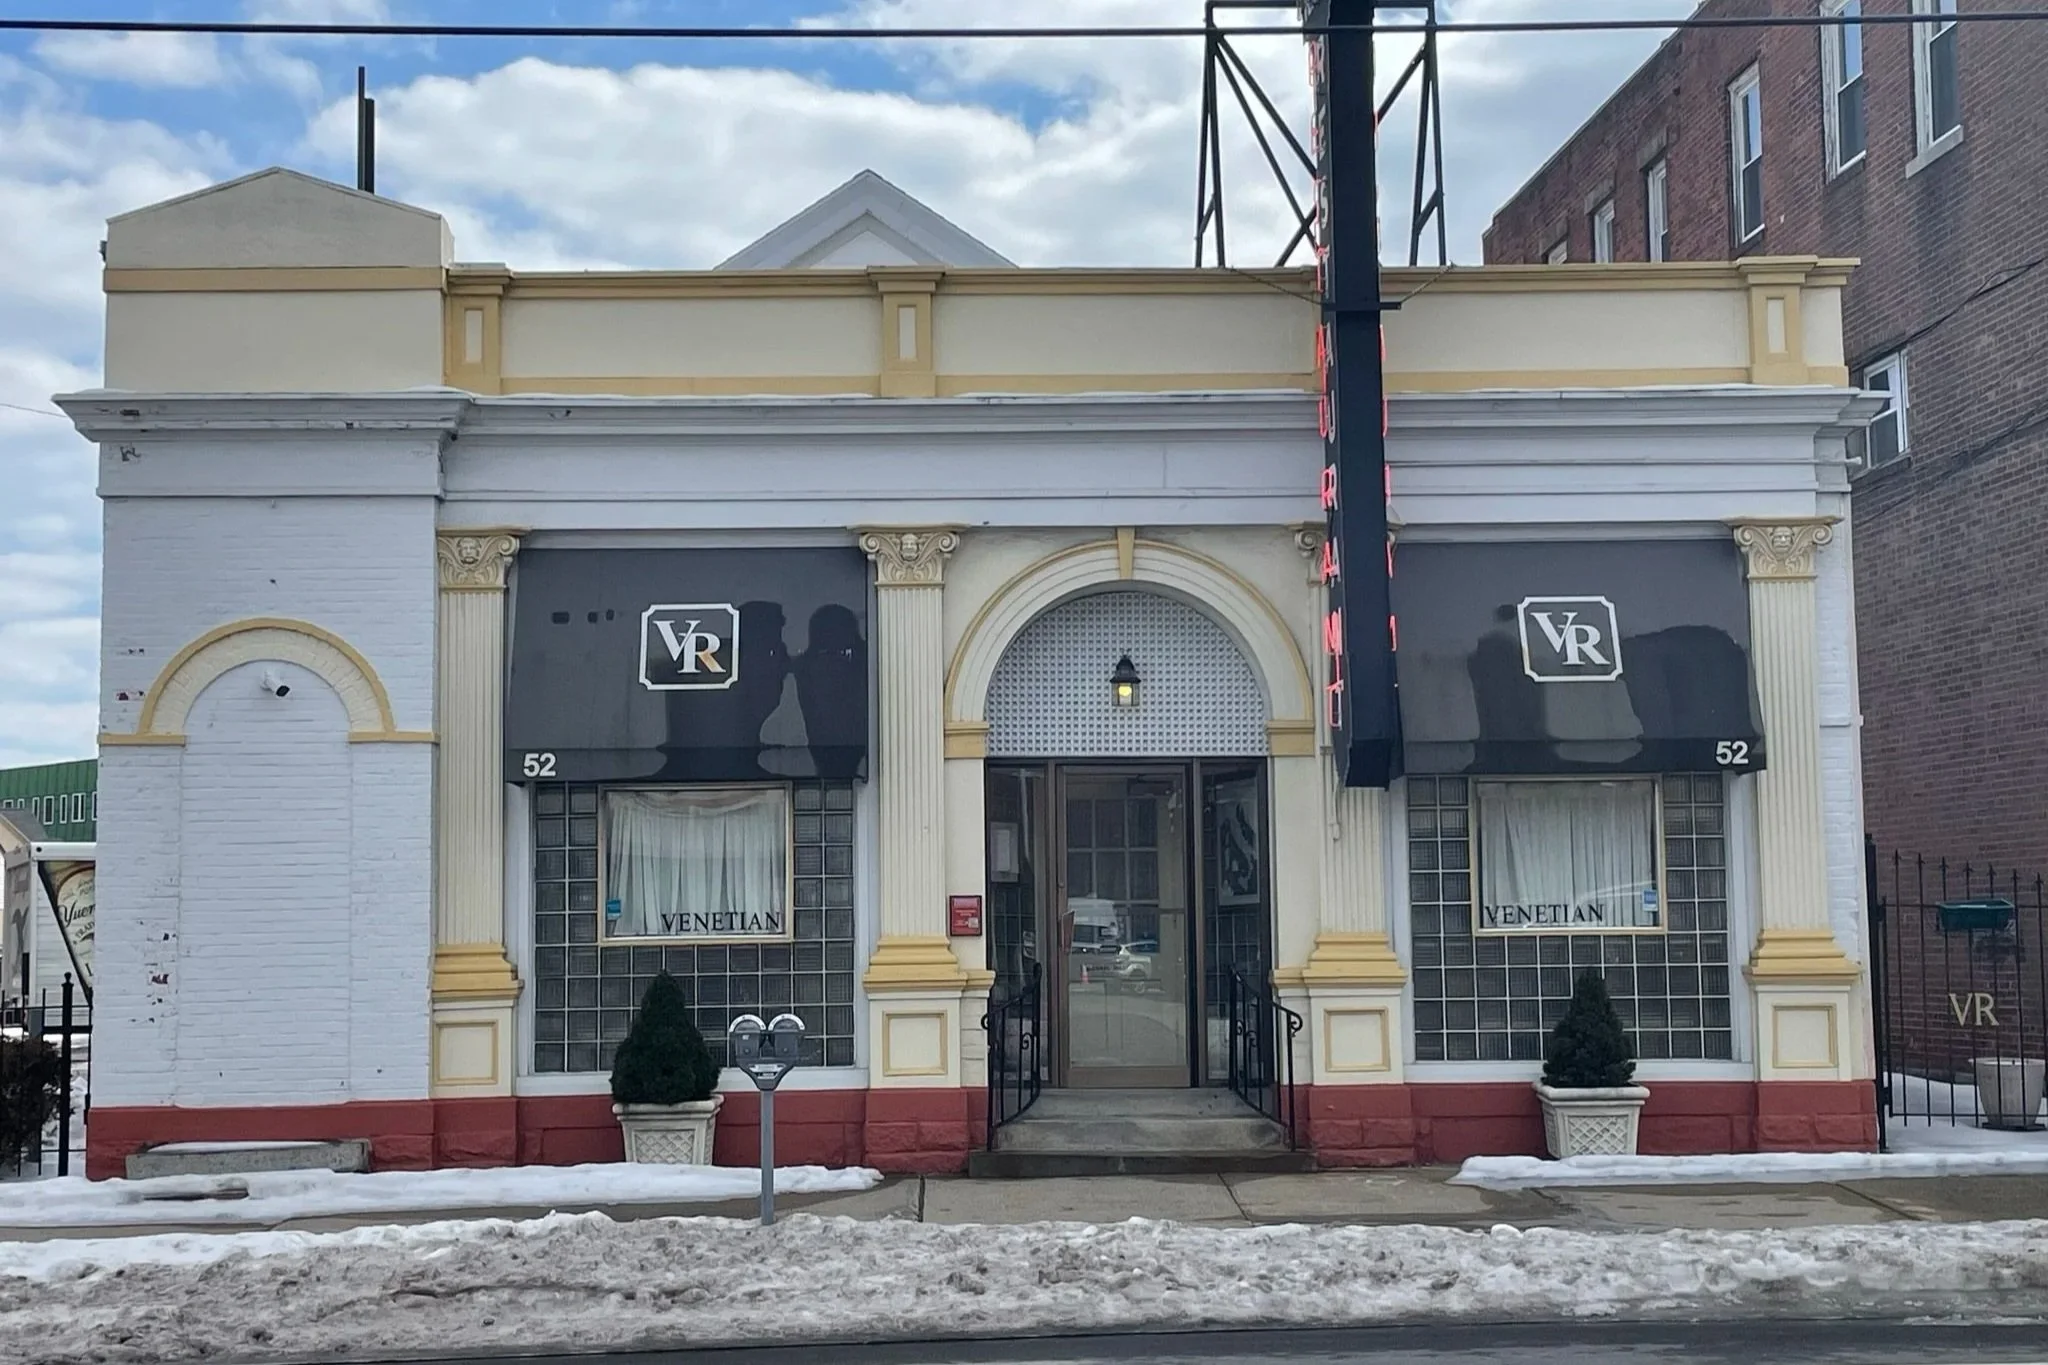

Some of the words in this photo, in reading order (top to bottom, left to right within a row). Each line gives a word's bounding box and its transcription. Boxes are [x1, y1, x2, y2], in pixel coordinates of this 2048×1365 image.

[652, 619, 727, 674] VR
[1529, 611, 1611, 665] VR
[523, 752, 557, 777] 52
[1715, 740, 1749, 765] 52
[660, 911, 781, 934] VENETIAN
[1484, 903, 1605, 925] VENETIAN
[1948, 992, 2000, 1027] VR
